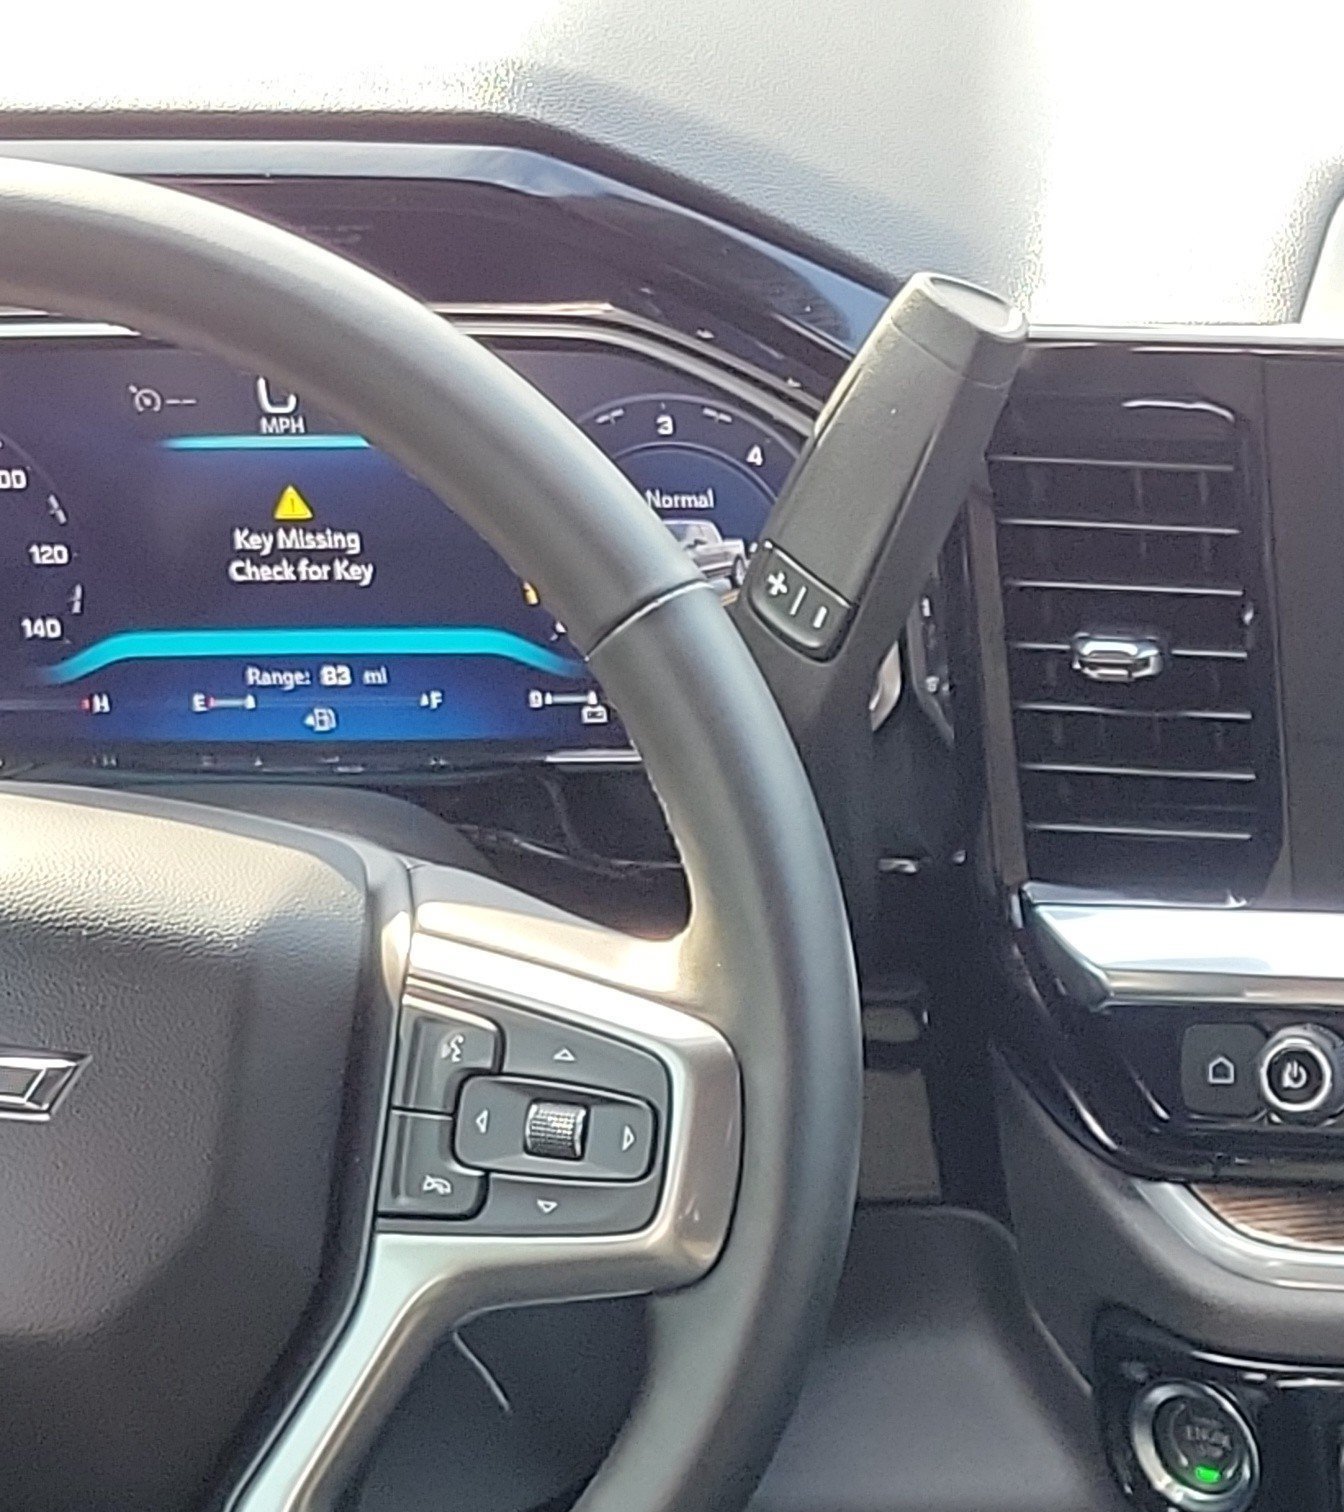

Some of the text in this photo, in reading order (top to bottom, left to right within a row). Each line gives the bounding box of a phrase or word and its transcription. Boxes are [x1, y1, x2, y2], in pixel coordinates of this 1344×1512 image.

[261, 415, 306, 434] MPH
[656, 415, 674, 435] 3
[746, 446, 763, 466] 4
[647, 489, 715, 509] Normal
[234, 528, 361, 556] Key Missing
[29, 544, 69, 564] 120
[228, 560, 374, 586] Check for Key
[21, 618, 62, 639] 140
[246, 667, 388, 689] Range: 83 mi
[192, 692, 208, 712] E
[429, 692, 443, 709] F
